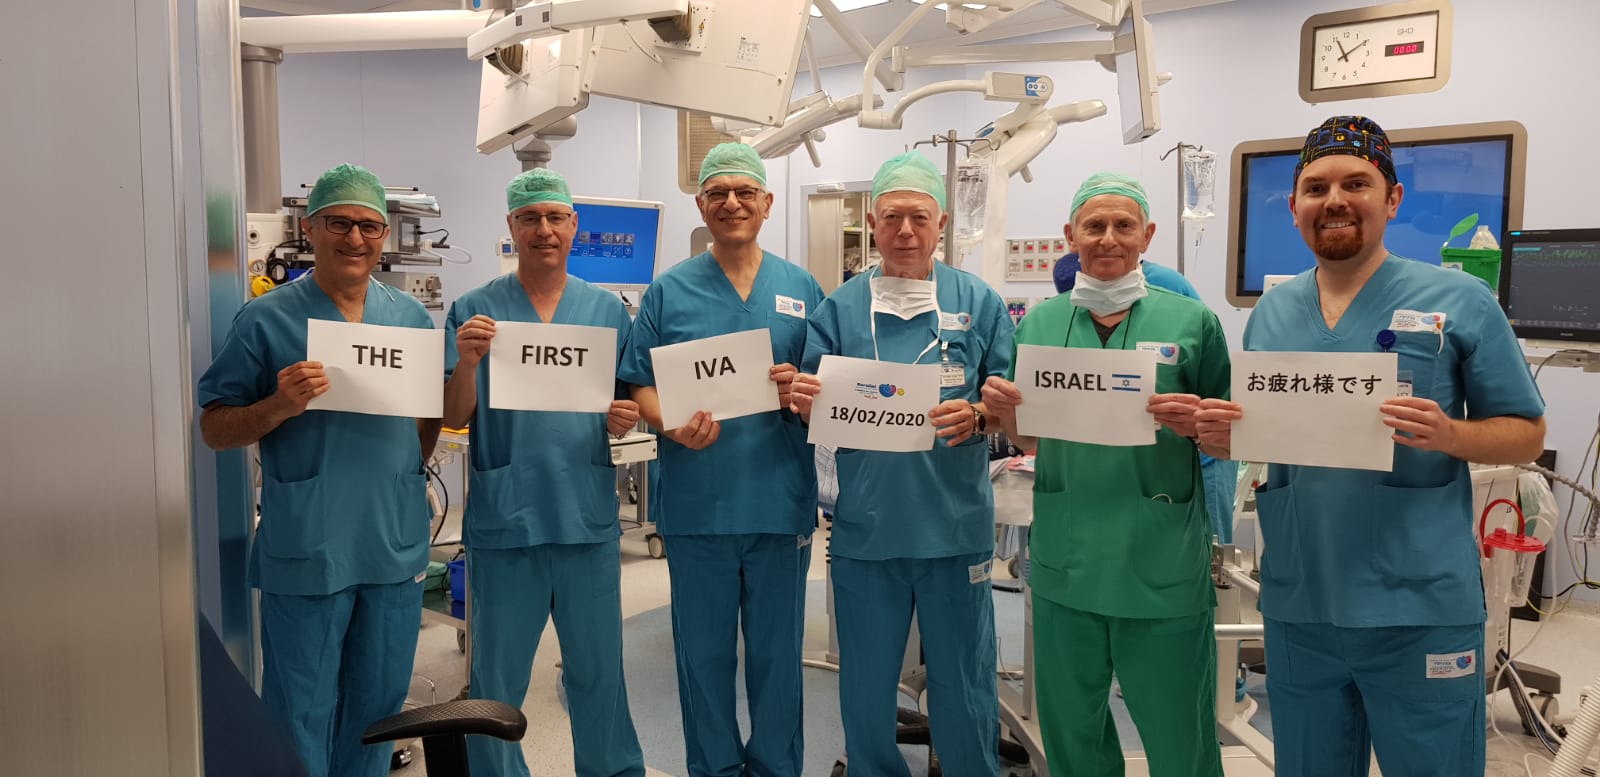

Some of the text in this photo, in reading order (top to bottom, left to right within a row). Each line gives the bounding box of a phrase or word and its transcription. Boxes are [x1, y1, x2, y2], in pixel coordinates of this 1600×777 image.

[352, 344, 403, 369] THE
[521, 344, 589, 368] FIRST
[694, 355, 737, 380] IVA
[1035, 370, 1107, 392] ISRAEL
[1247, 371, 1383, 396] お疲れ様です
[830, 405, 925, 427] 18/02/2020
